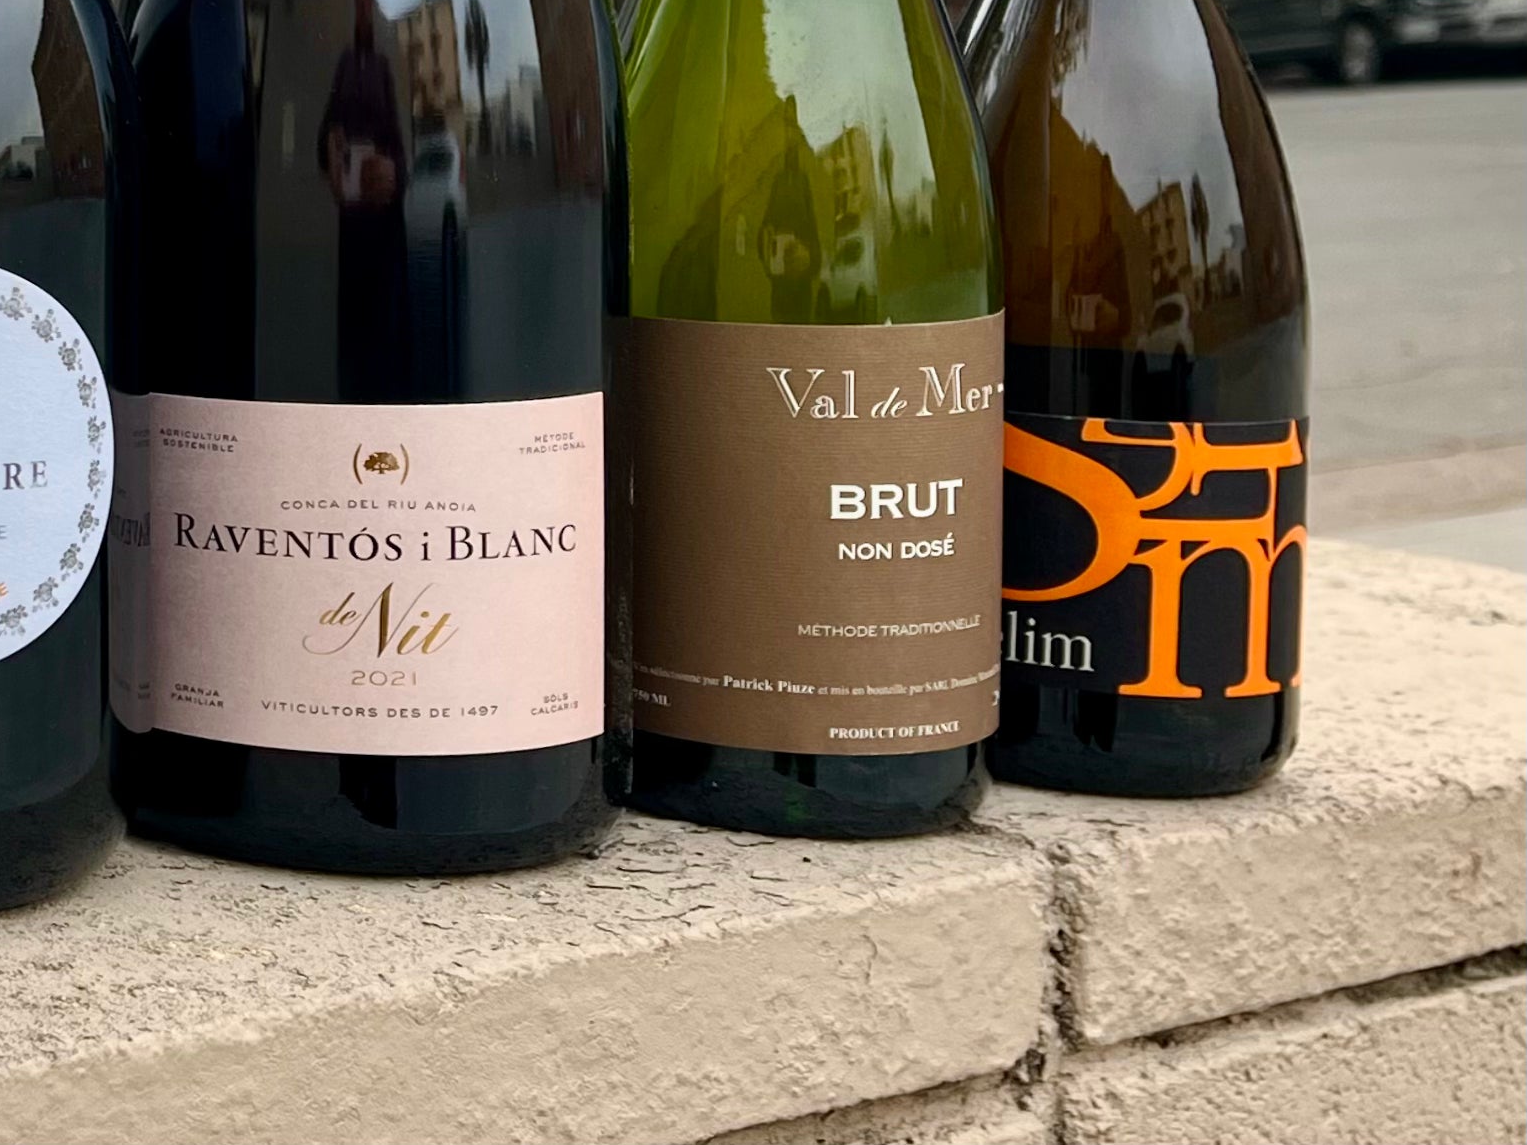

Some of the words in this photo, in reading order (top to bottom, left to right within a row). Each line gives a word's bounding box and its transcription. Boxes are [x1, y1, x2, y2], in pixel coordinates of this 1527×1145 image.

[766, 367, 859, 419] Val
[871, 387, 908, 419] de
[159, 428, 238, 443] AGRICULTURA
[163, 438, 234, 453] SOSTENIBLE
[519, 441, 586, 455] TRADICIONAL
[280, 499, 340, 511] CONCA
[346, 499, 379, 510] DEL
[387, 500, 417, 511] RIU
[424, 501, 477, 512] ANOIA
[830, 478, 963, 520] BRUT
[174, 512, 403, 562] RAVENTÓS
[421, 531, 432, 562] i
[446, 523, 578, 562] BLANC
[838, 541, 893, 560] NON
[900, 533, 955, 559] DOSÉ
[318, 591, 361, 626] de
[301, 581, 461, 659] Nit
[881, 615, 981, 637] TRADITIONNELLE
[1001, 610, 1095, 673] lim
[350, 670, 418, 687] 2021
[723, 675, 774, 692] Patrick
[777, 680, 816, 695] Piuze
[830, 685, 850, 696] mis
[852, 687, 865, 695] en
[174, 683, 220, 697] GRANJA
[171, 693, 224, 708] FAMILIAR
[261, 700, 378, 719] VITICULTORS
[386, 707, 420, 719] DES
[428, 707, 451, 718] DE
[460, 704, 499, 717] 1497
[829, 727, 895, 739] PRODUCT
[898, 726, 914, 737] OF
[917, 720, 960, 737] FRANCE
